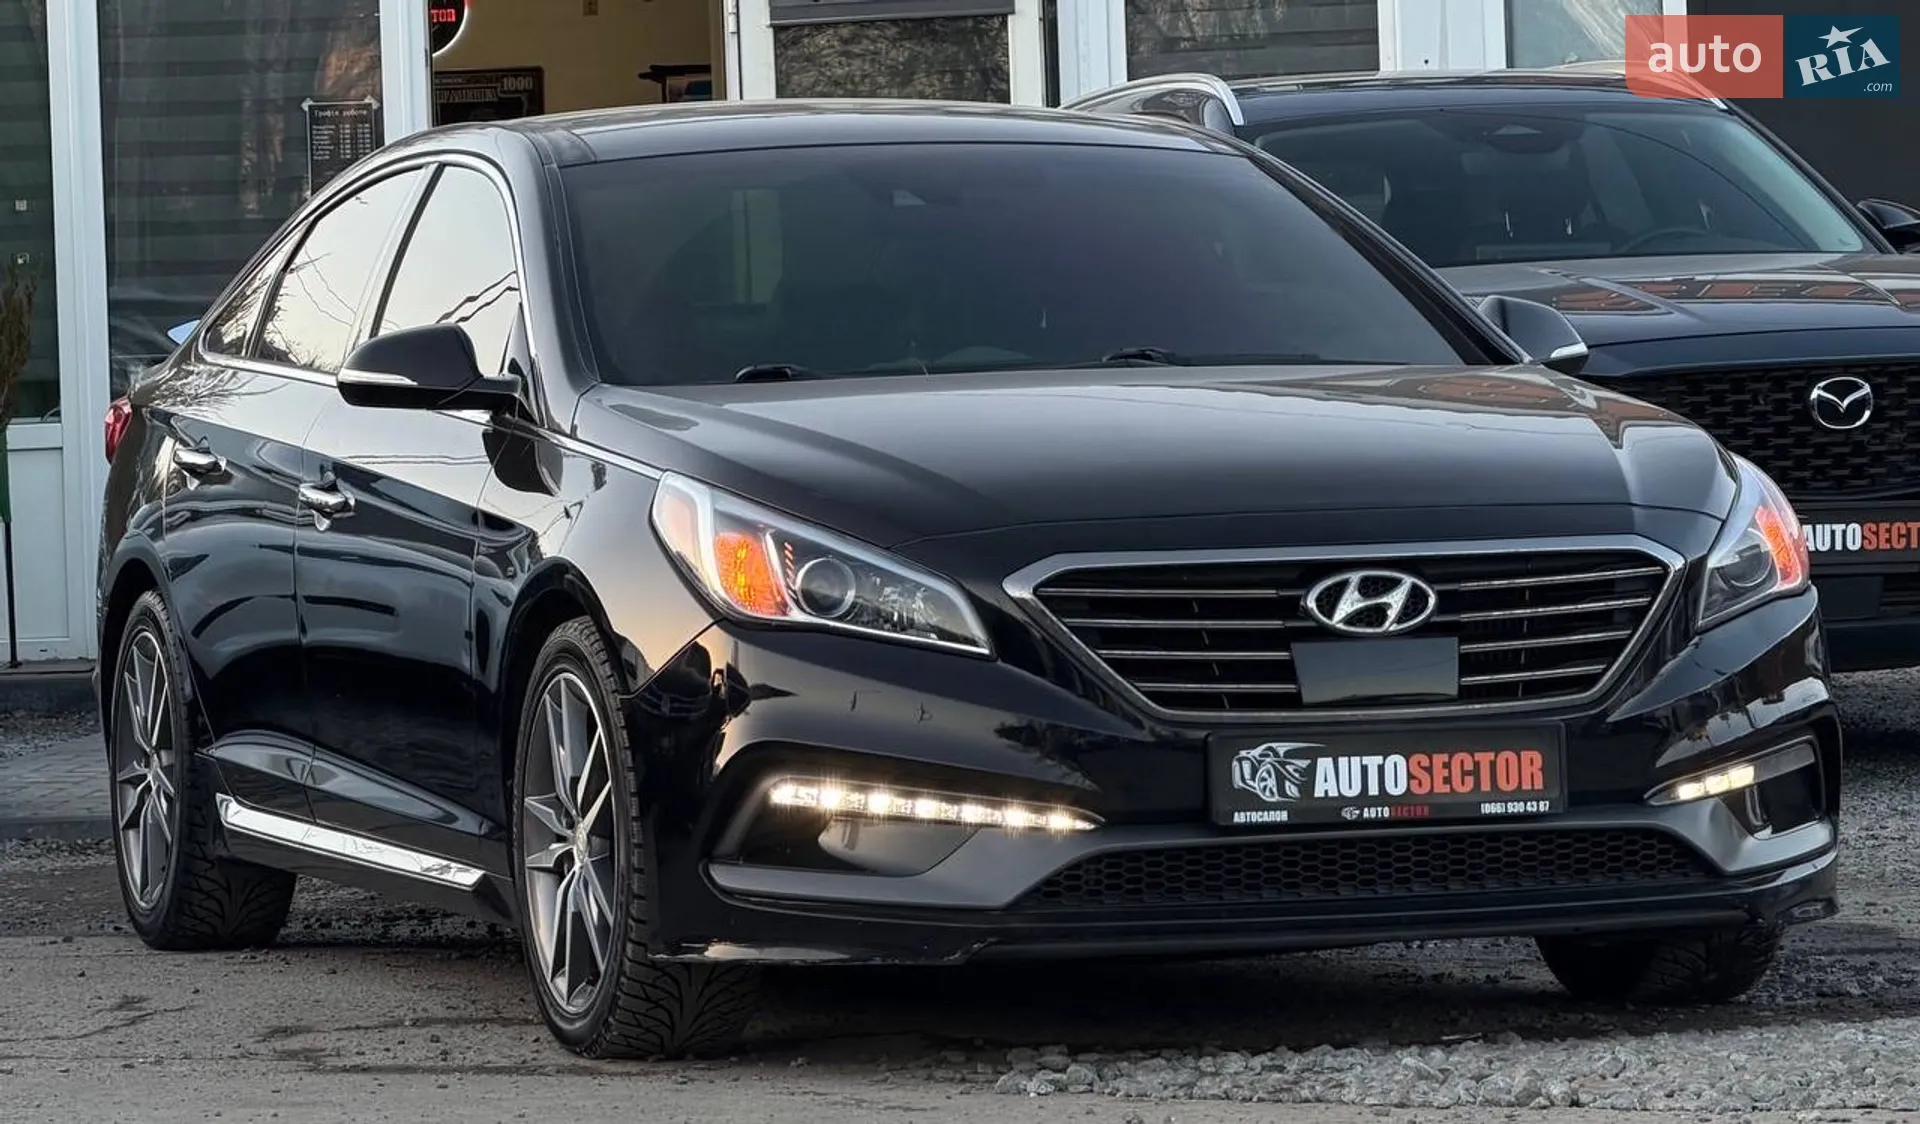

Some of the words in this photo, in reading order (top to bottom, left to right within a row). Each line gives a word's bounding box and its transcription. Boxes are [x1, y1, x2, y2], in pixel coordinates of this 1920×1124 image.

[1314, 751, 1544, 798] AUTOSECTOR
[1507, 801, 1525, 813] 930
[1526, 801, 1538, 812] 43
[1539, 800, 1550, 812] 87
[1233, 810, 1288, 823] АВТОСАЛОН
